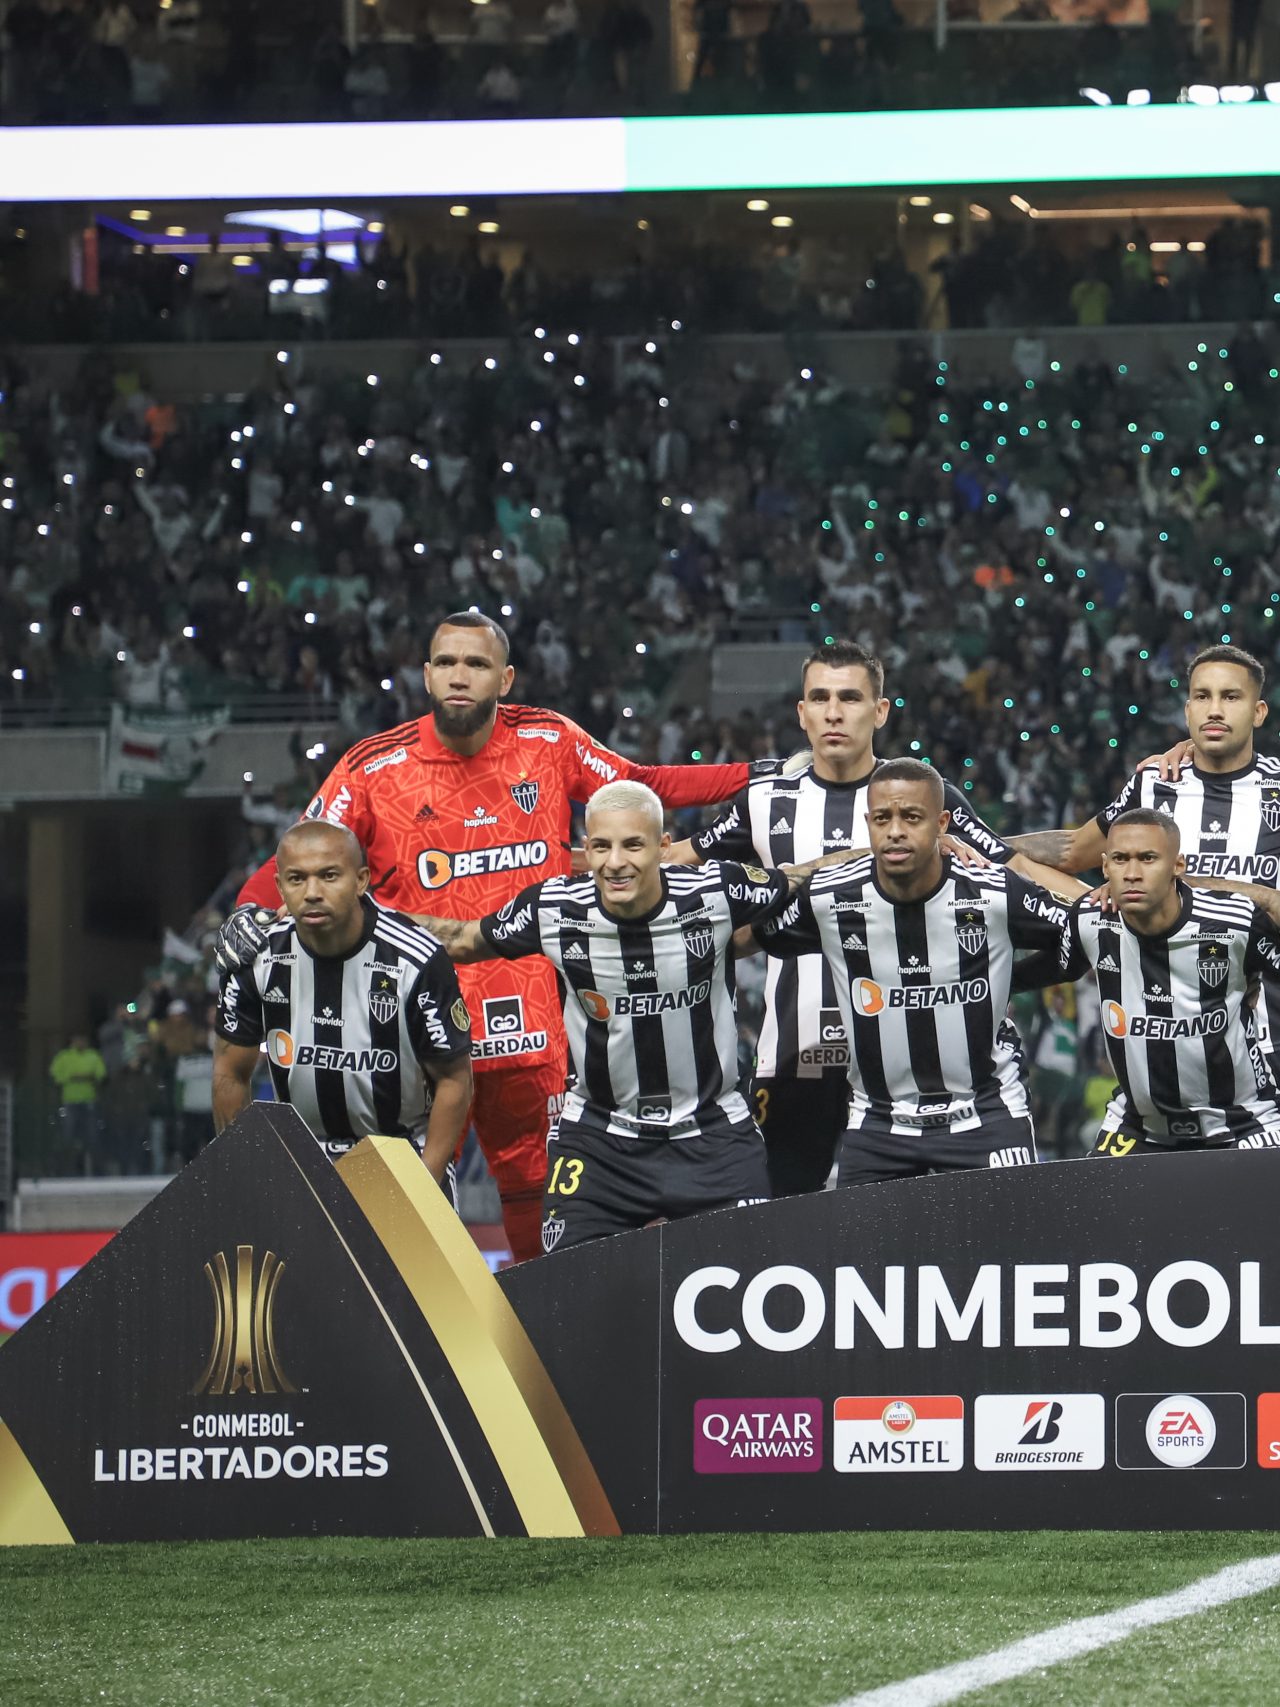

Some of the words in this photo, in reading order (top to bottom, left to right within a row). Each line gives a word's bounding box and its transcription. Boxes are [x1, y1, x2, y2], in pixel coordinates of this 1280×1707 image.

[583, 751, 618, 781] MRV
[464, 815, 498, 828] hapvida
[713, 804, 740, 841] MRV
[964, 822, 1005, 855] MRV
[454, 840, 546, 878] BETANO
[744, 887, 779, 904] MRV
[505, 903, 532, 935] MRV
[1037, 901, 1067, 928] MR
[562, 952, 588, 960] adidas
[623, 970, 658, 982] hapvida
[899, 964, 932, 975] hapvida
[614, 982, 710, 1015] BETANO
[888, 979, 989, 1010] BETANO
[1142, 990, 1175, 1003] hapvida
[312, 1016, 345, 1027] hapvida
[423, 1008, 451, 1050] MRV
[1129, 1008, 1227, 1040] BETANO
[470, 1034, 546, 1058] GERDAU
[296, 1046, 398, 1073] BETANO
[1248, 1043, 1267, 1089] buse
[895, 1106, 973, 1127] GERDAU
[989, 1146, 1031, 1168] AUTO
[547, 1156, 585, 1195] 13
[702, 1412, 814, 1446] QATAR
[1159, 1411, 1203, 1435] EA
[730, 1441, 814, 1459] AIRWAYS
[848, 1440, 950, 1465] AMSTEL
[1157, 1436, 1204, 1447] SPORTS
[95, 1444, 389, 1482] LIBERTADORES
[995, 1451, 1084, 1464] BRIDGESTONE
